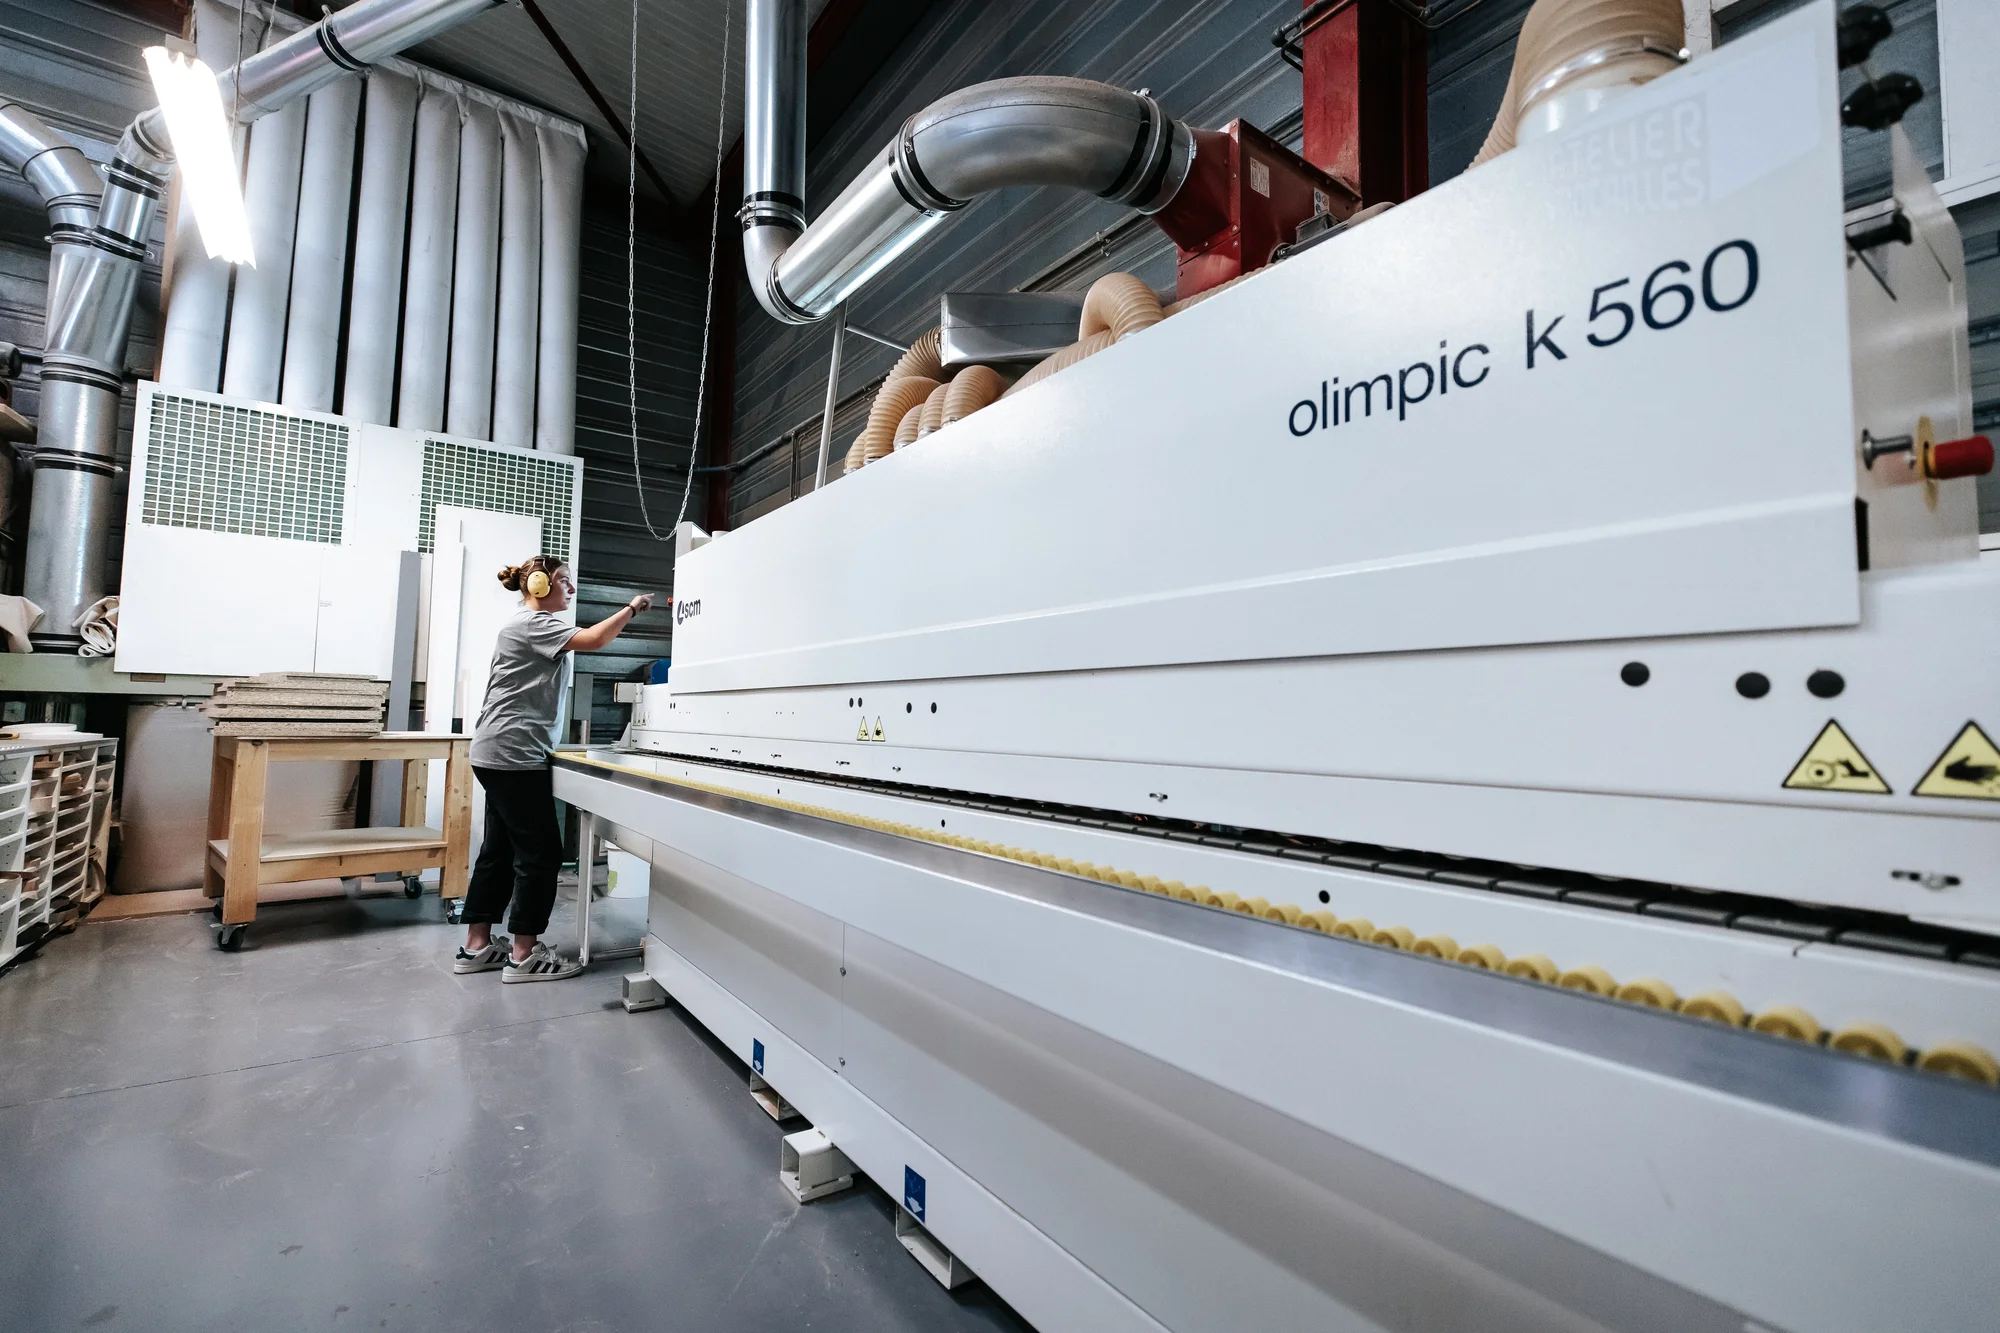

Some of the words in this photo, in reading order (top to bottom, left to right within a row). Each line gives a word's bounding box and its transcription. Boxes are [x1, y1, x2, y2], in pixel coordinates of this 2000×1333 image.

[1288, 340, 1490, 437] olimpic
[1586, 239, 1760, 348] 560
[684, 598, 701, 619] scm
